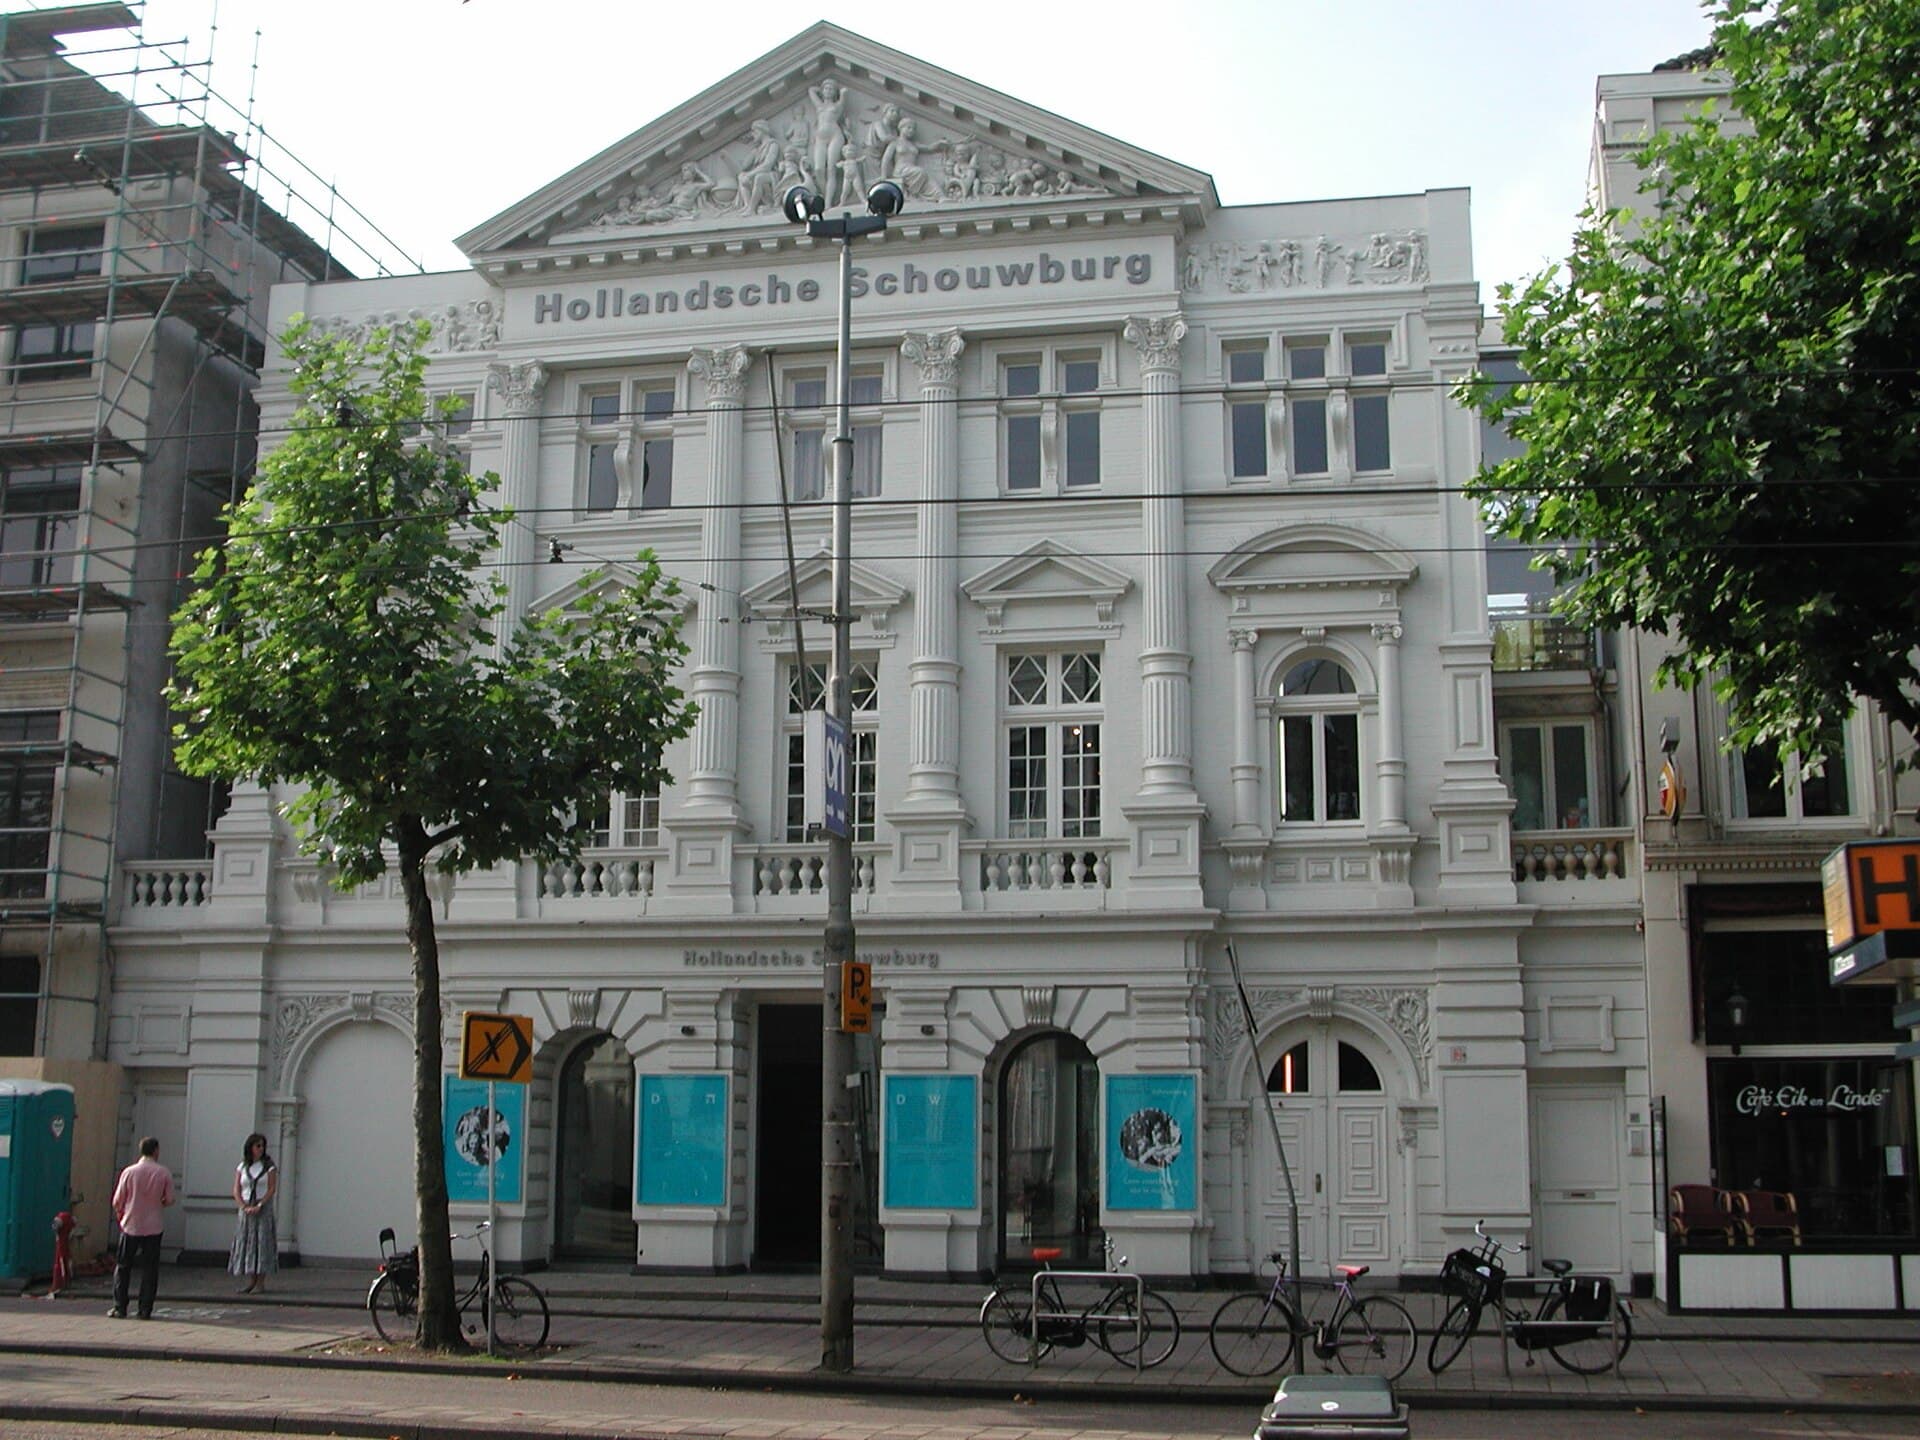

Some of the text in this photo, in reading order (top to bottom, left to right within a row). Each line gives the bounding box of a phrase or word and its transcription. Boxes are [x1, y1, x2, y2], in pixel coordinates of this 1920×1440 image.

[535, 252, 1152, 323] Hollandsche Schouwburg
[1859, 854, 1920, 925] H
[683, 950, 941, 969] Hollandsche Suwburg
[1736, 1085, 1774, 1116] Café
[1809, 1097, 1823, 1106] en
